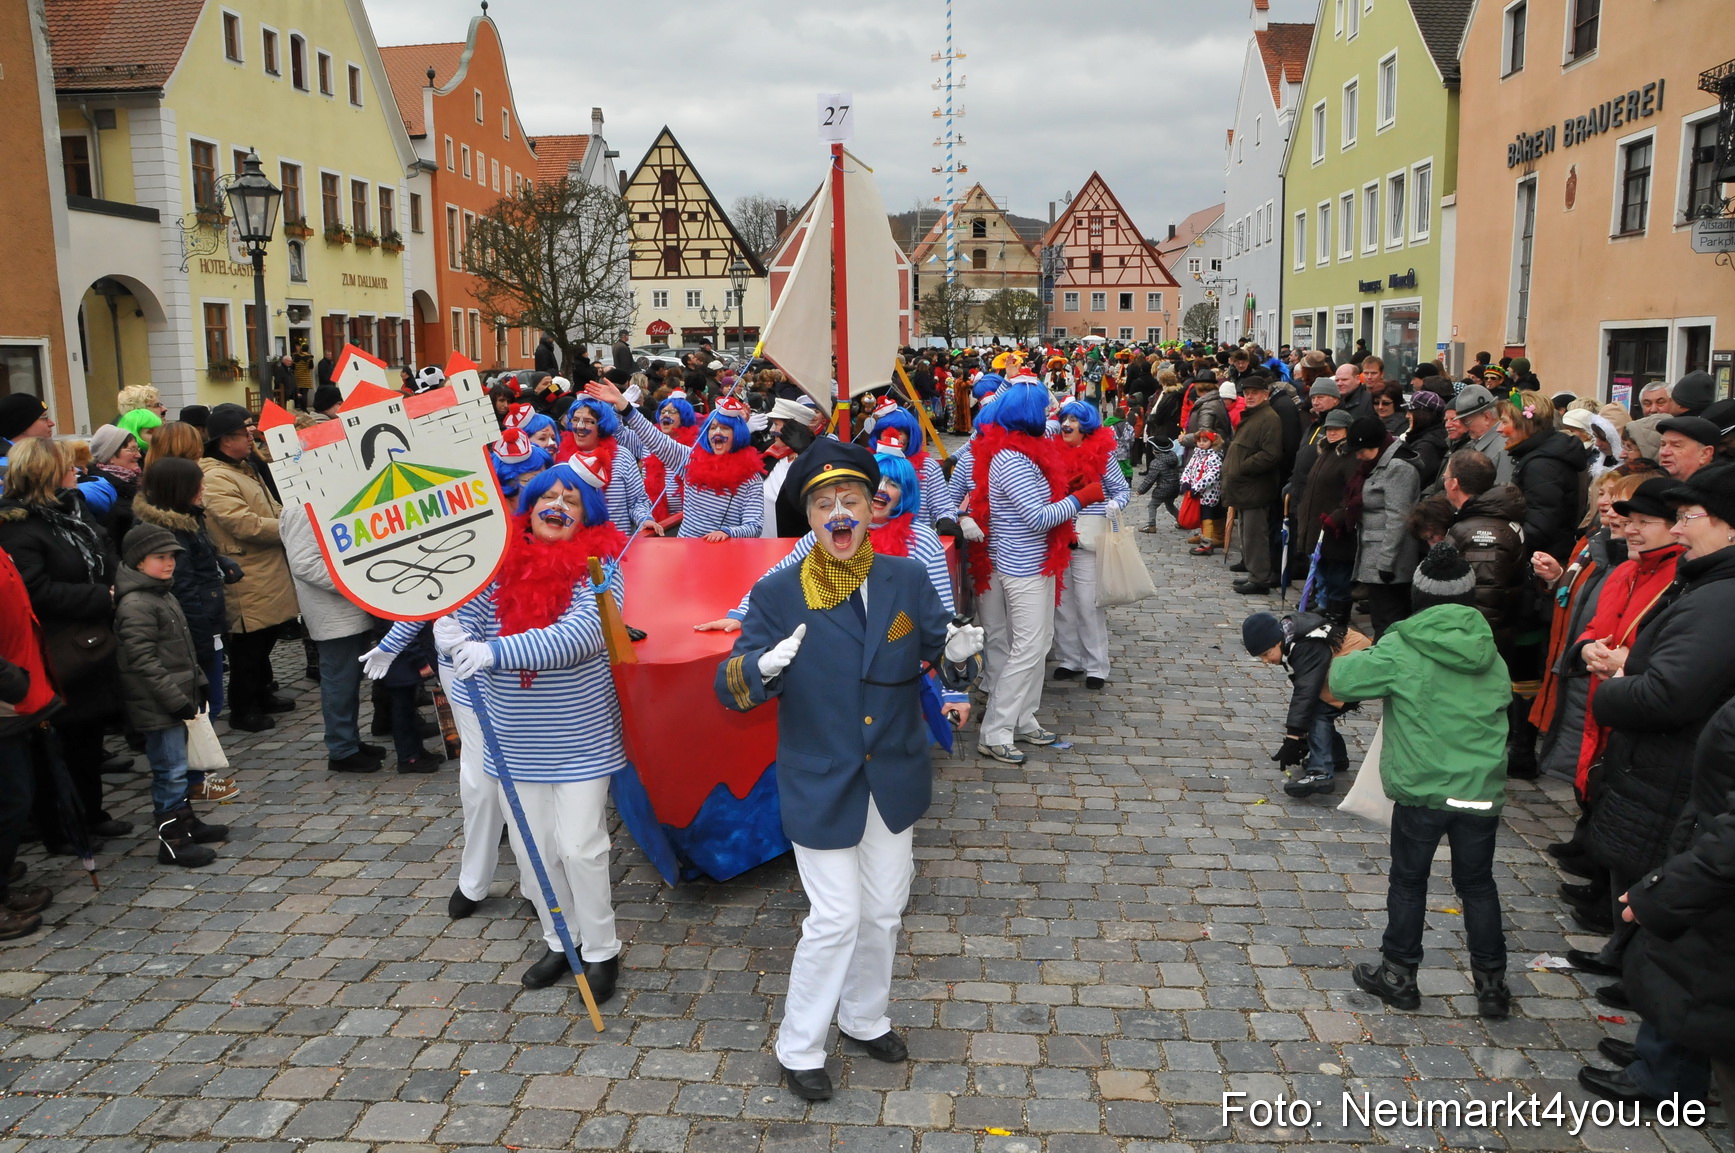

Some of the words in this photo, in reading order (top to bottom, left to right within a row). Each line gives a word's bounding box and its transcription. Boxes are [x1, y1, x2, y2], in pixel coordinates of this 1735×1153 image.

[823, 105, 850, 126] 27
[1507, 125, 1556, 169] BÄREN
[1563, 78, 1665, 148] BRAUEREI
[341, 272, 356, 286] ZUM
[357, 274, 388, 290] DALLMAYR
[331, 479, 489, 553] BACHAMINIS
